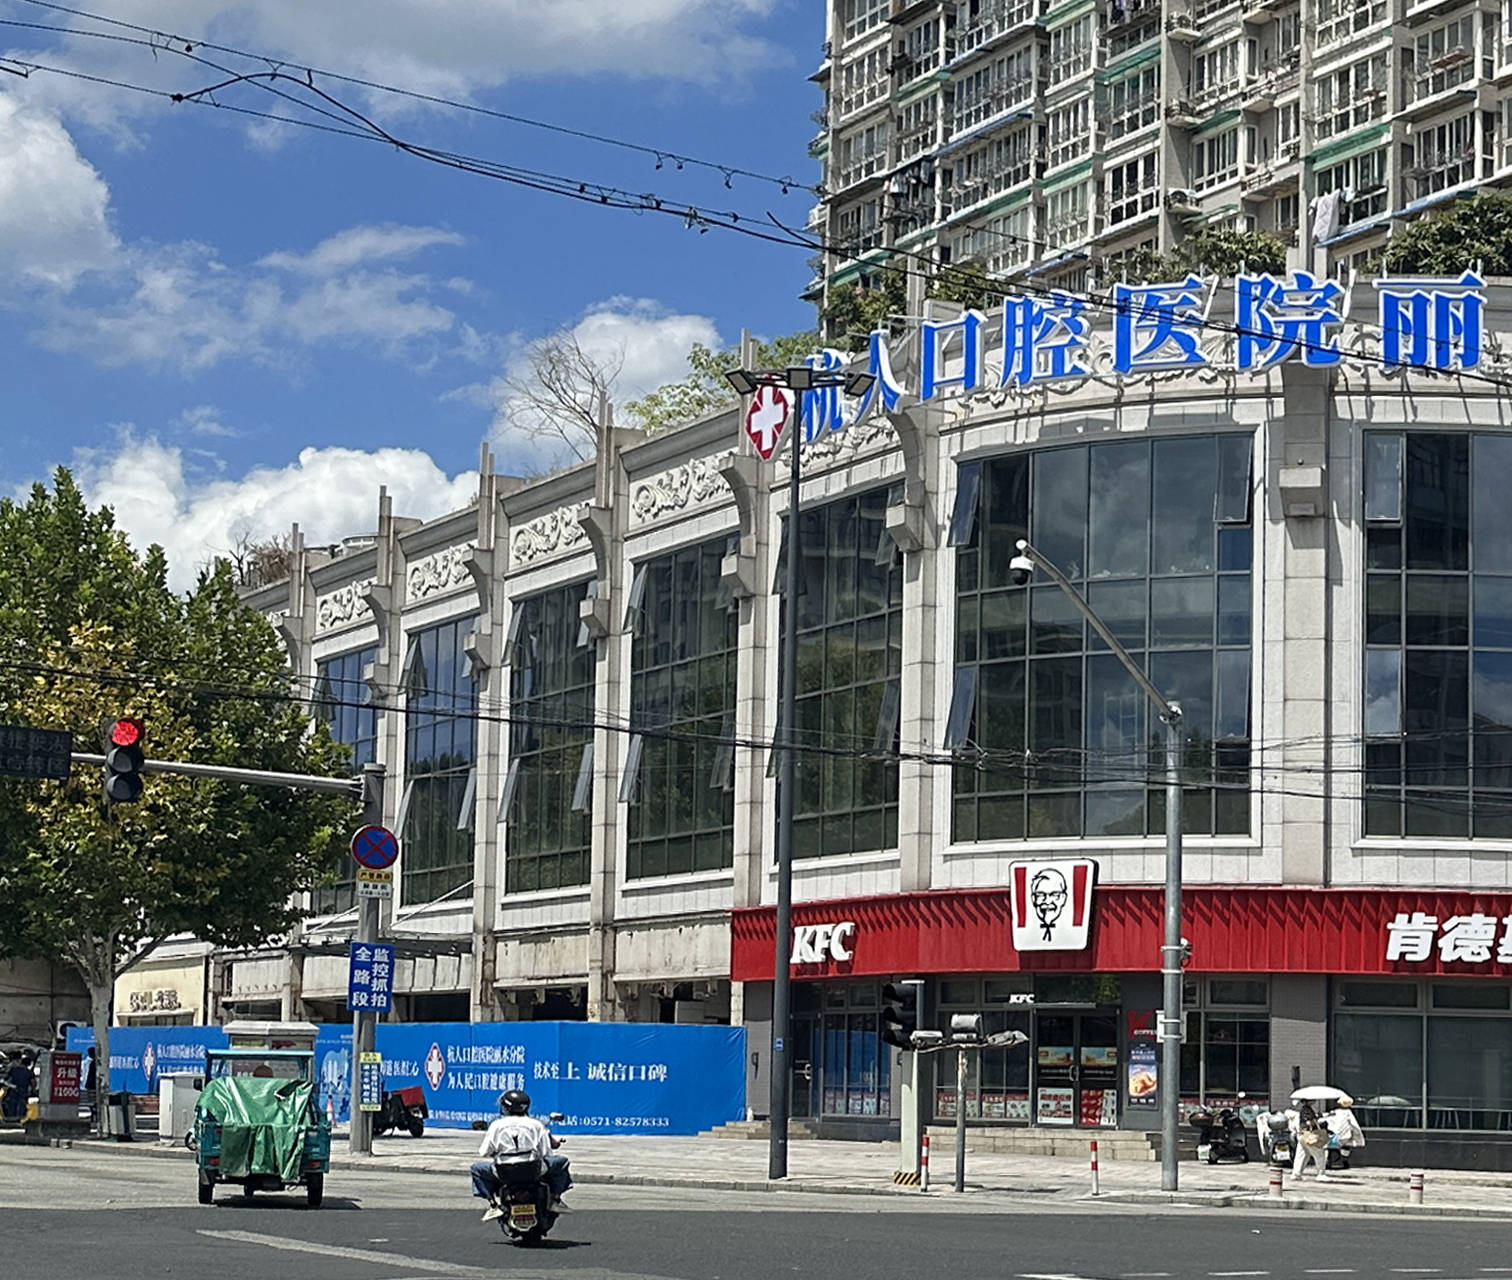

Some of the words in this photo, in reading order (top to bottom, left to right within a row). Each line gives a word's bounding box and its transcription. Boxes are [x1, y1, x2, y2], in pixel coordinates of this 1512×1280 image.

[789, 922, 856, 964] KFC
[351, 947, 372, 1007] 全路段
[370, 949, 390, 1007] 监控抓拍
[1009, 994, 1034, 1004] KFC
[587, 1062, 668, 1082] 诚信口碑
